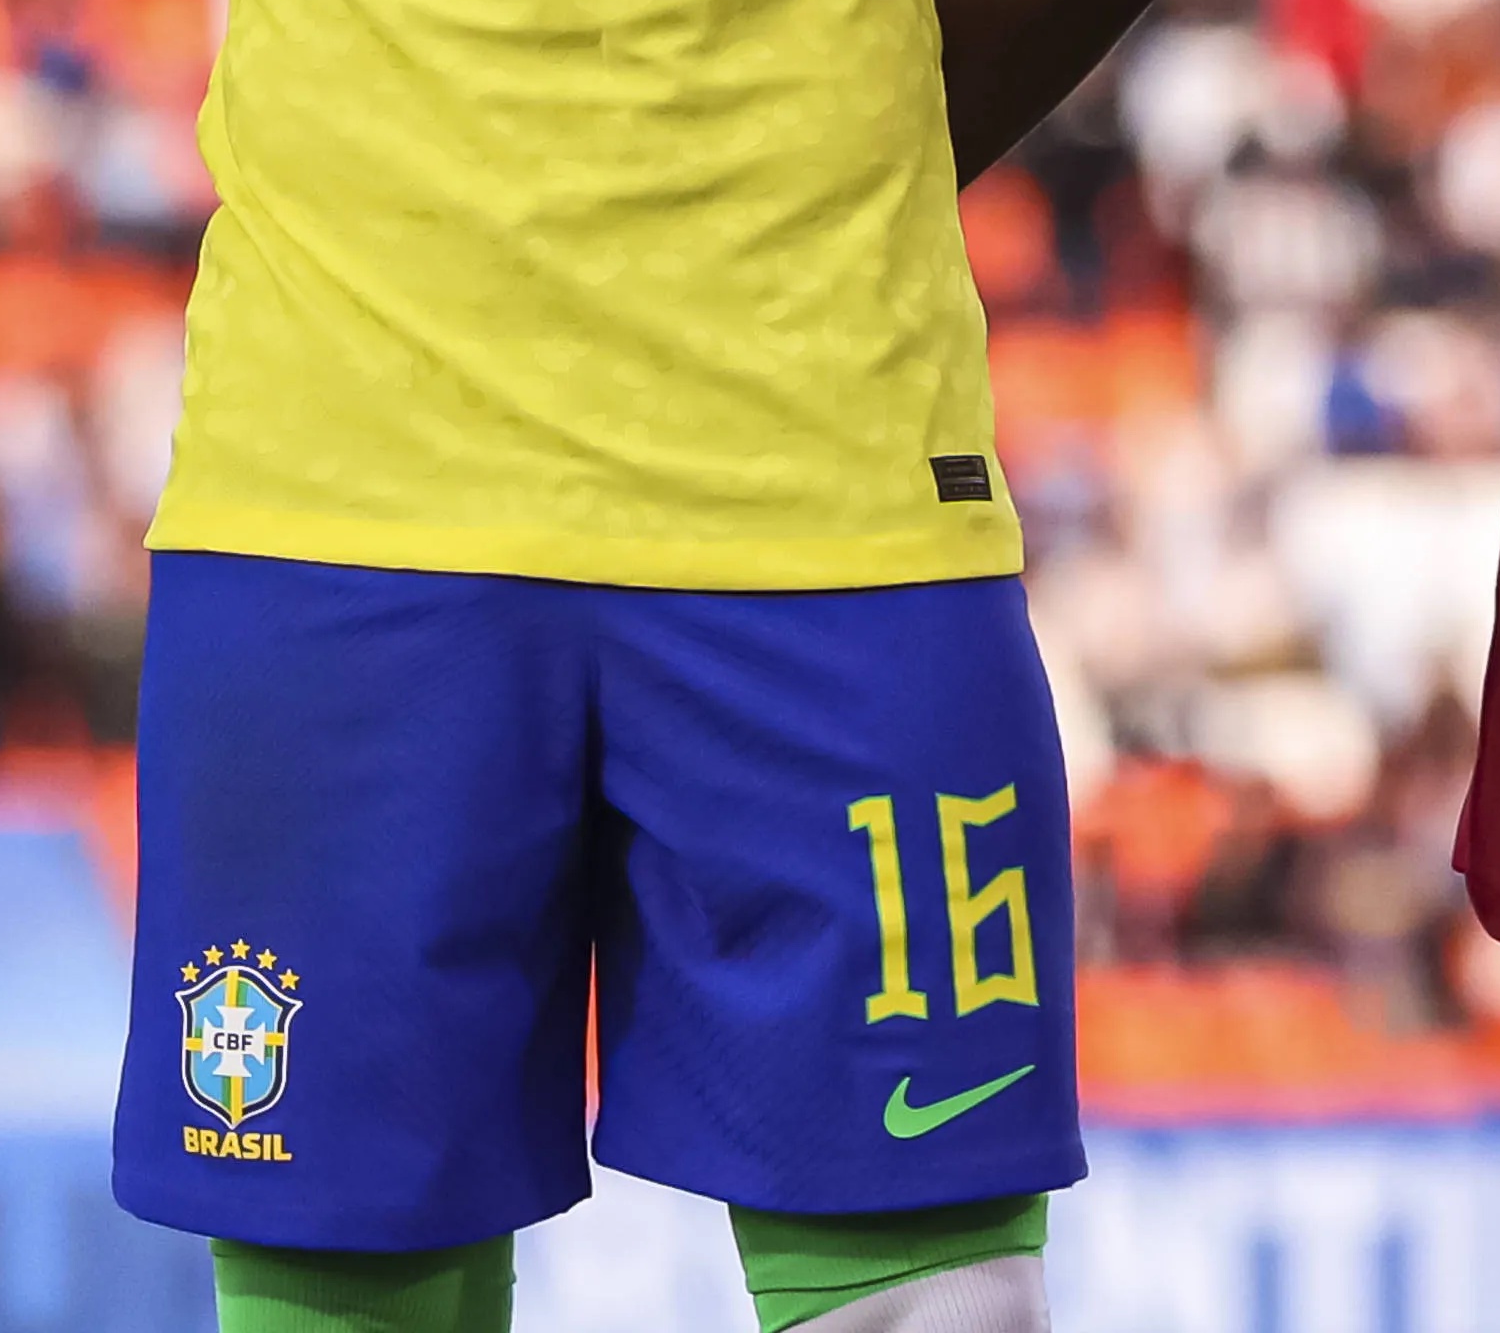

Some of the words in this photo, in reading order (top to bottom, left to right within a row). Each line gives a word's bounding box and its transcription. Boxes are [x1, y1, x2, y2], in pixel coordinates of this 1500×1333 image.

[847, 781, 1040, 1025] 16
[213, 1032, 254, 1052] CBF
[183, 1125, 293, 1162] BRASIL
